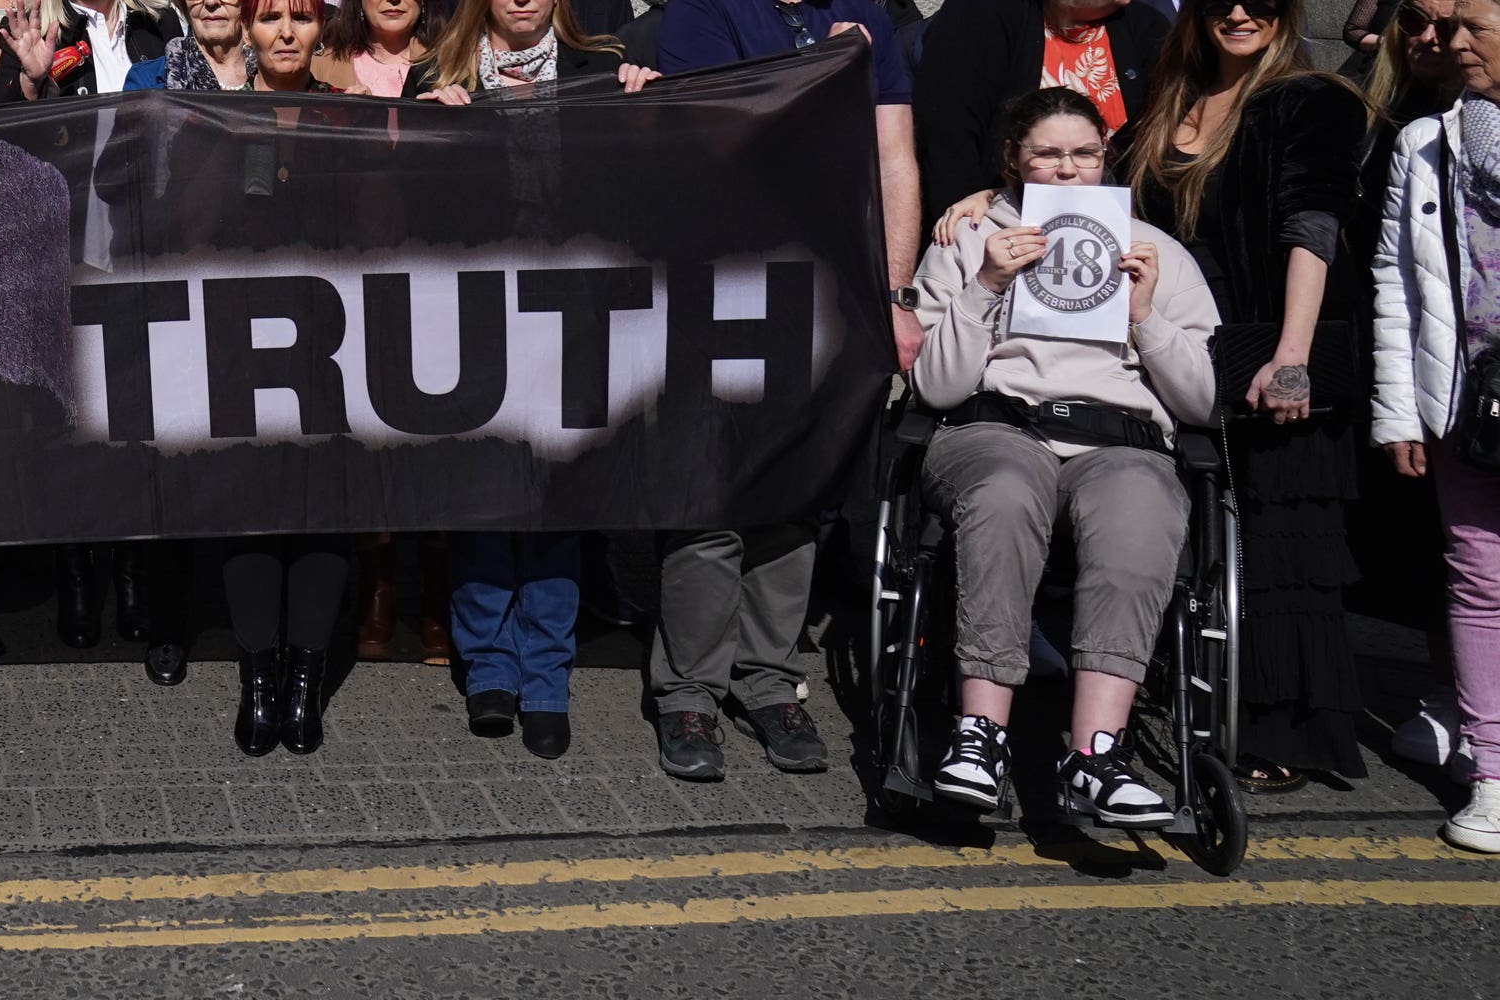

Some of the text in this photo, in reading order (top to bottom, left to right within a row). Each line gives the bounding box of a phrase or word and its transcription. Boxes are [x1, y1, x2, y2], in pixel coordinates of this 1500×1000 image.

[1042, 217, 1117, 252] AWFULLY KILLED
[1038, 237, 1104, 289] 48
[1037, 290, 1097, 310] FEBRUARY
[1097, 279, 1118, 300] 1981
[71, 261, 815, 442] TRUTH
